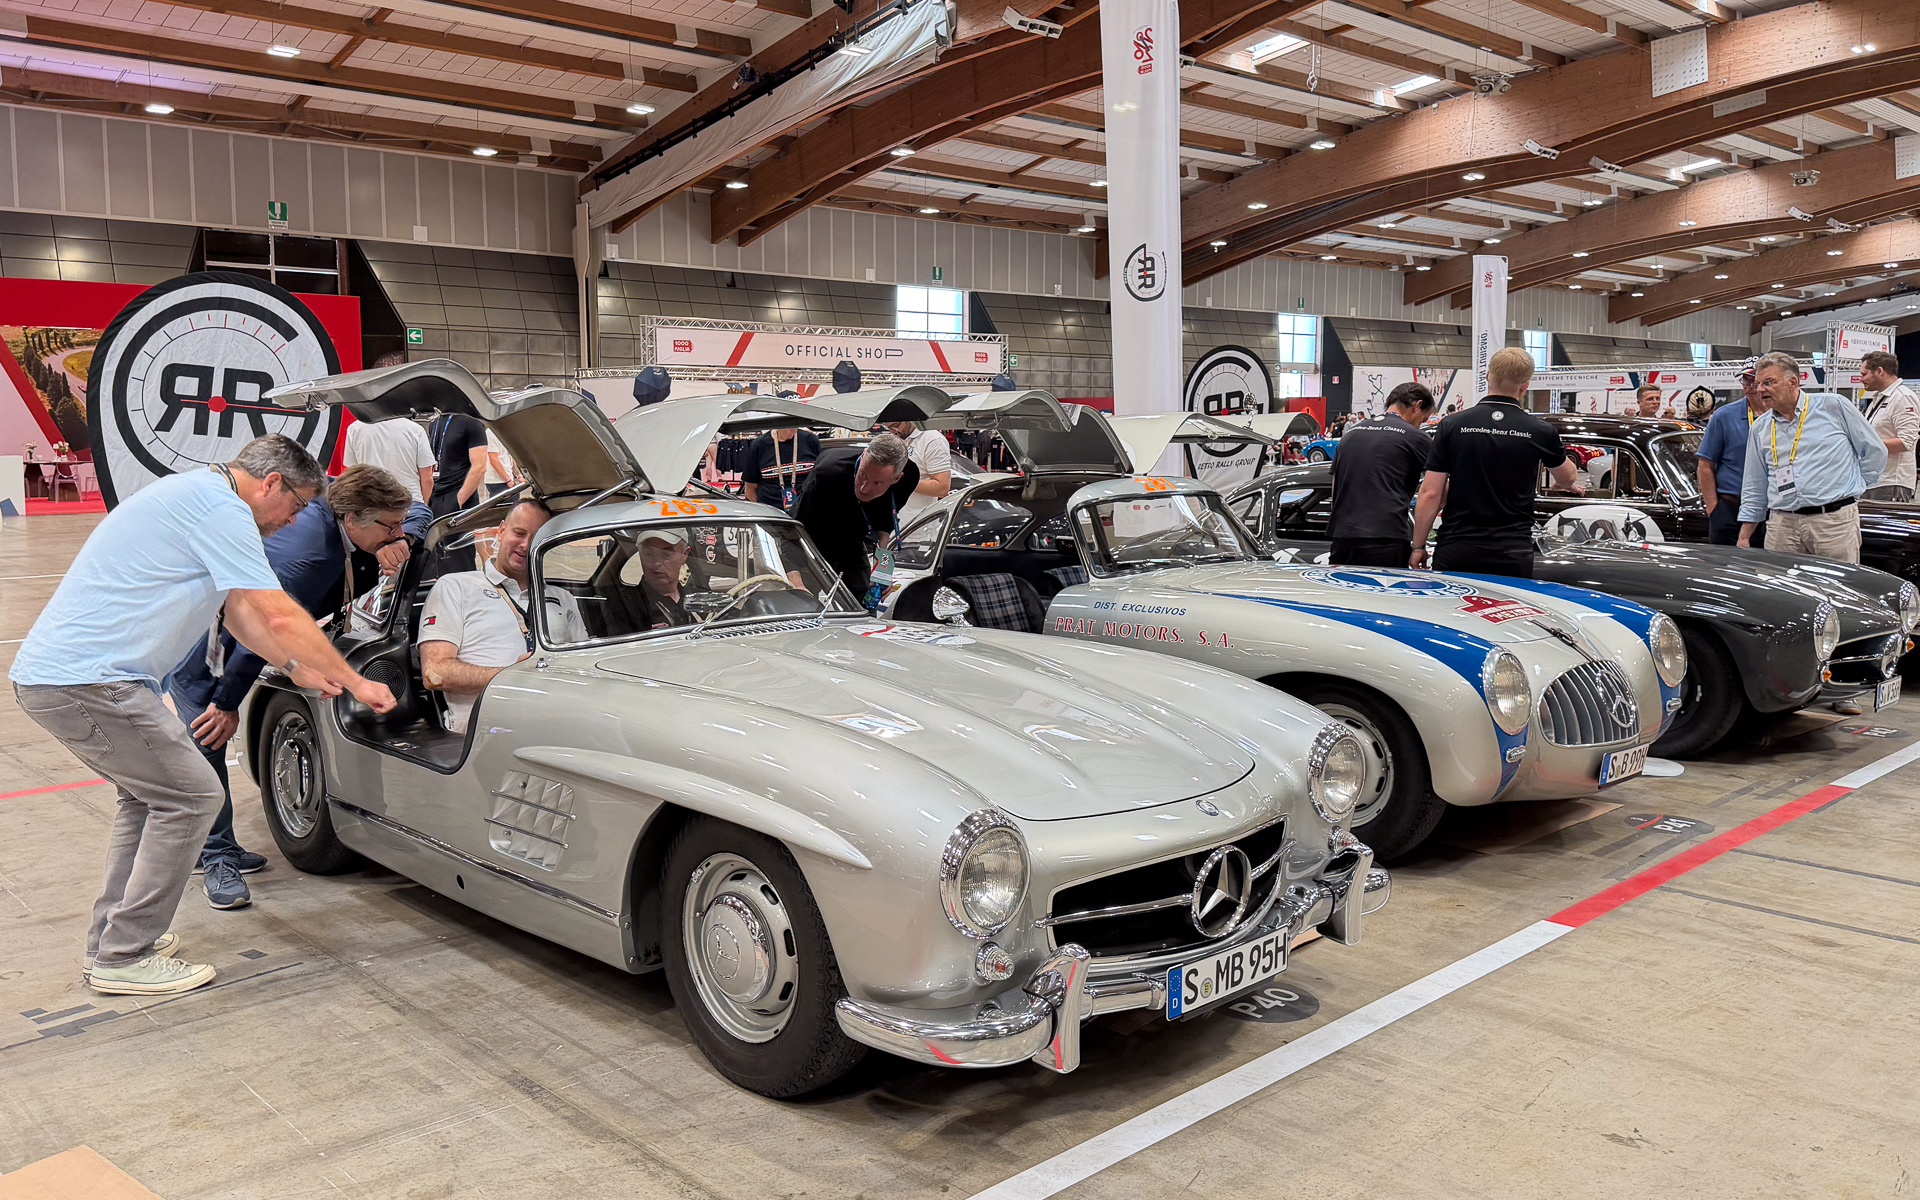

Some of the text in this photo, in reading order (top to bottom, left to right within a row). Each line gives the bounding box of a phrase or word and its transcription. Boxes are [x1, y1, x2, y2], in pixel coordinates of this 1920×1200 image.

[785, 344, 904, 359] OFFICIAL SHOP
[1384, 426, 1406, 434] Classic
[1460, 426, 1532, 438] Mercedes-Benz Classic
[1216, 460, 1233, 468] RALLY
[1235, 458, 1255, 468] GROUP
[648, 499, 718, 516] 285
[1094, 601, 1186, 616] DIST. EXCLUSIVOS
[1054, 616, 1096, 634] PRAT
[1102, 620, 1185, 643] MOTORS.
[1608, 756, 1617, 779] S
[1621, 753, 1629, 775] B
[1172, 932, 1287, 1009] D S MB 95H
[1229, 988, 1300, 1019] P40
